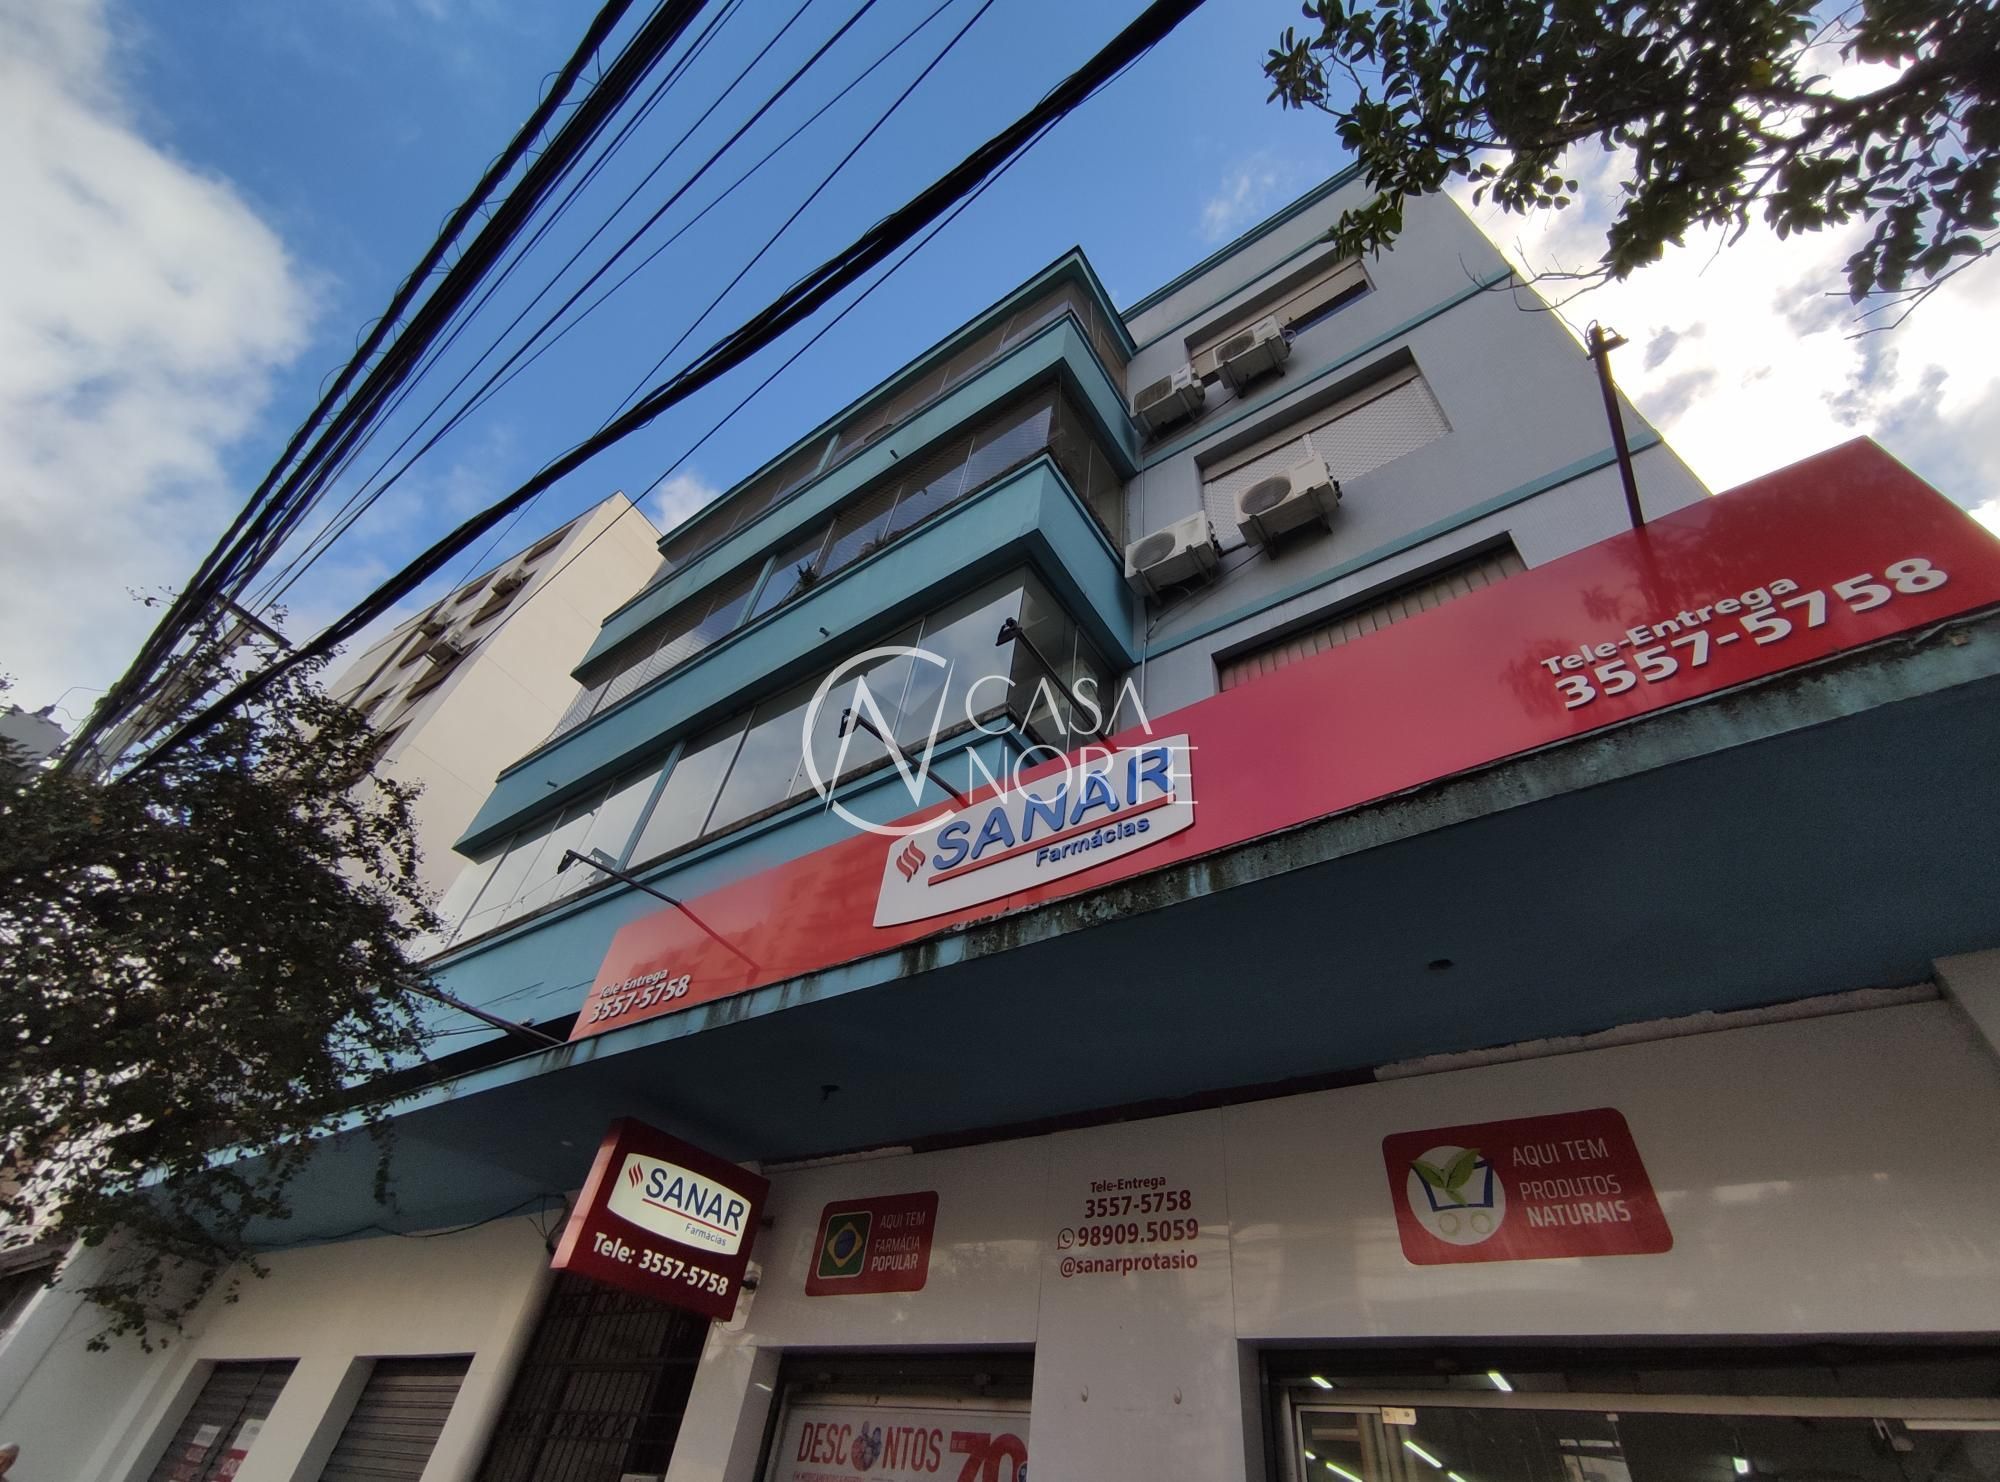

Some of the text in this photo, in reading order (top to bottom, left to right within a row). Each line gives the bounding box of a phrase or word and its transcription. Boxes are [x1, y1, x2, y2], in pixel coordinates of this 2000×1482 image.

[1541, 578, 1798, 676] Tele-Entrega
[1555, 557, 1948, 709] 3557-5758
[932, 747, 1176, 871] SANAR
[1035, 817, 1150, 868] Farmácias
[588, 974, 692, 1024] 3557-5758
[600, 969, 669, 999] Tele Entrega
[1512, 1138, 1609, 1167] AQUI TEM
[645, 1167, 745, 1231] SANAR
[1090, 1176, 1166, 1193] Tele-Entrega
[1519, 1174, 1622, 1201] PRODUTOS
[1084, 1189, 1192, 1219] 3557-5758
[1526, 1200, 1632, 1228] NATURAIS
[879, 1210, 926, 1229] AQUI TEM
[1077, 1218, 1199, 1247] 98909.5059
[593, 1231, 729, 1296] Tele: 3557-5758
[871, 1253, 919, 1272] POPULAR
[1060, 1249, 1198, 1278] @sanarprotasio
